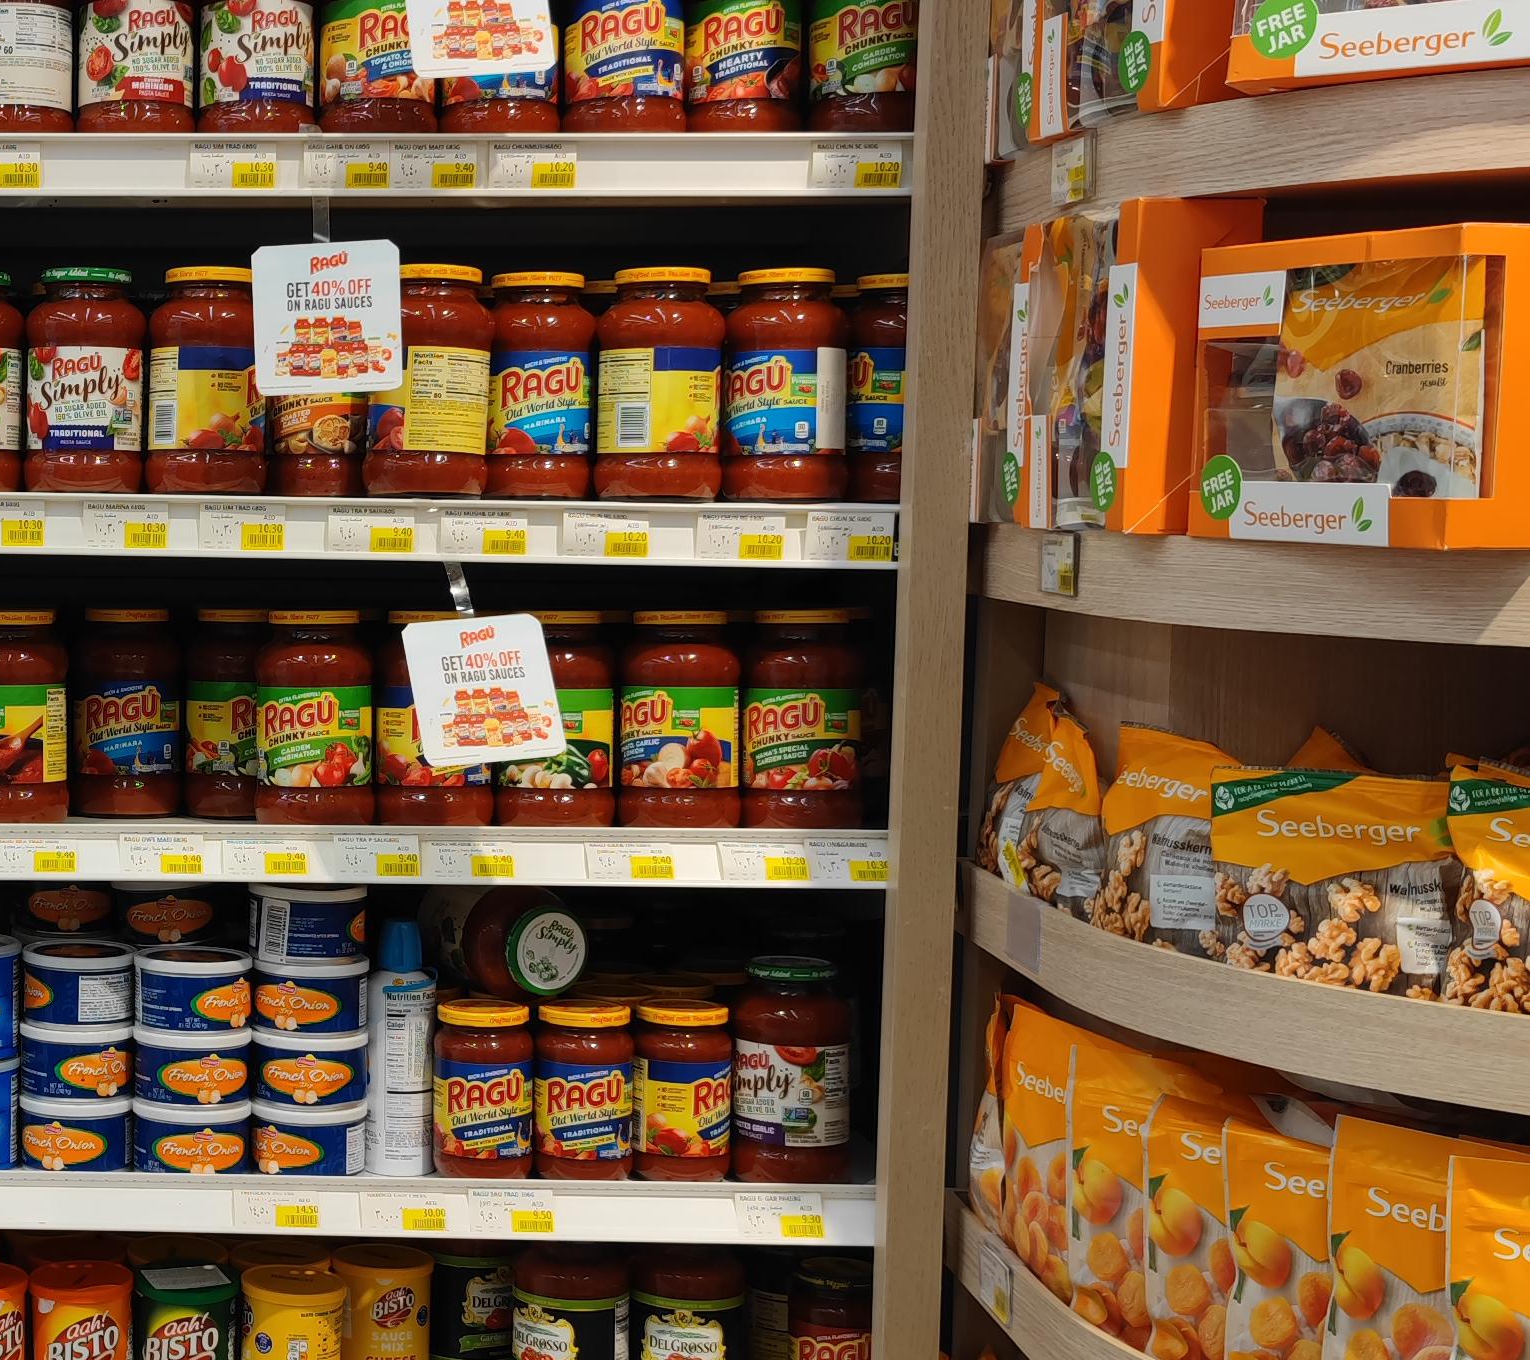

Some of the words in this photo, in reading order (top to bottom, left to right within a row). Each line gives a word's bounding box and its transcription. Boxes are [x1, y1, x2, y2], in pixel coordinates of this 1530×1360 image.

[128, 8, 177, 32] RAGÚ
[580, 0, 662, 45] RAGÚ
[1256, 4, 1306, 37] FREE
[1268, 25, 1309, 54] JAR
[1319, 28, 1475, 60] Seeberger
[719, 53, 763, 71] HEARTY
[549, 163, 574, 172] 10.20
[874, 163, 899, 172] 10.20
[286, 280, 309, 298] GET
[313, 278, 346, 296] 40%
[347, 279, 372, 294] OFF
[287, 298, 299, 310] ON
[303, 297, 331, 309] RAGU
[334, 295, 373, 308] SAUCES
[1292, 287, 1426, 313] Seeberger
[1386, 358, 1449, 376] Cranberries
[40, 367, 123, 402] Simply
[1013, 325, 1030, 448] Seeberger
[1246, 904, 1282, 919] TOP
[1249, 917, 1283, 930] MARKE
[448, 1070, 520, 1112] RAGÚ
[162, 1143, 200, 1159] French
[203, 1141, 243, 1158] Onion
[295, 1205, 318, 1214] 14.50
[422, 1208, 446, 1217] 30.00
[533, 1211, 552, 1219] 9.50
[802, 1215, 820, 1223] 9.30
[66, 1313, 106, 1337] aah!
[372, 1330, 414, 1341] SAUCE
[649, 1335, 718, 1354] DELGROSSO
